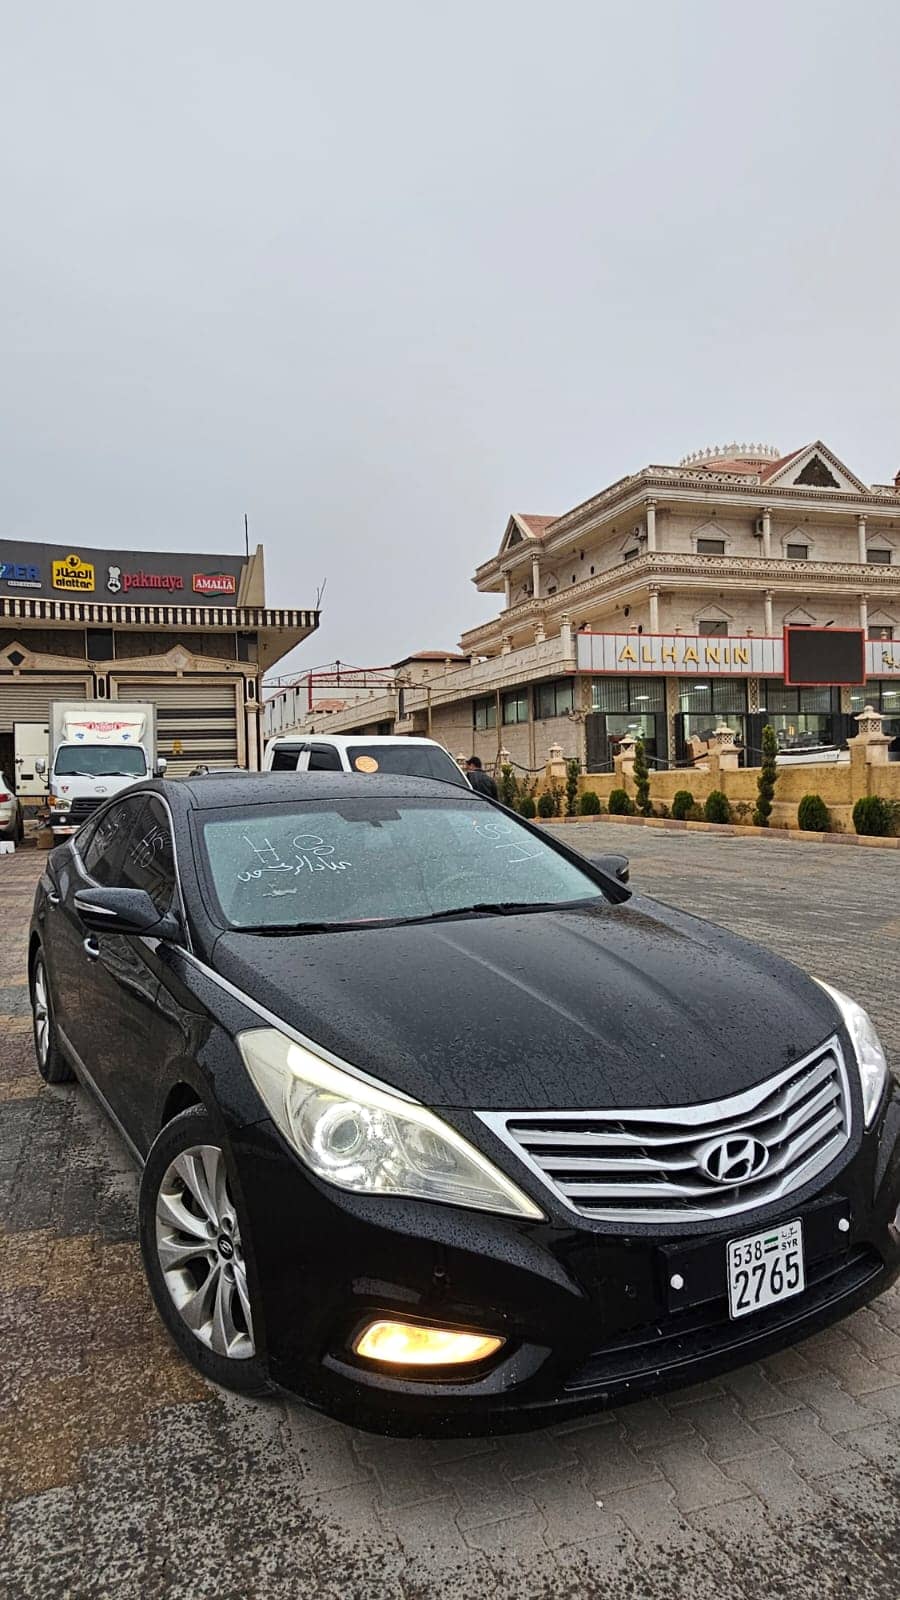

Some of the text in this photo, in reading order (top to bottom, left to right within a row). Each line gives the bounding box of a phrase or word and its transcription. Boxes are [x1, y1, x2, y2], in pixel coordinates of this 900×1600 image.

[56, 567, 92, 580] العطار
[122, 570, 185, 592] pakmaya
[56, 579, 92, 589] alattar
[195, 578, 233, 590] AMALIA
[618, 644, 749, 664] ALHANIN
[781, 1238, 798, 1251] SYR
[734, 1240, 762, 1268] 538
[735, 1251, 799, 1310] 2765
